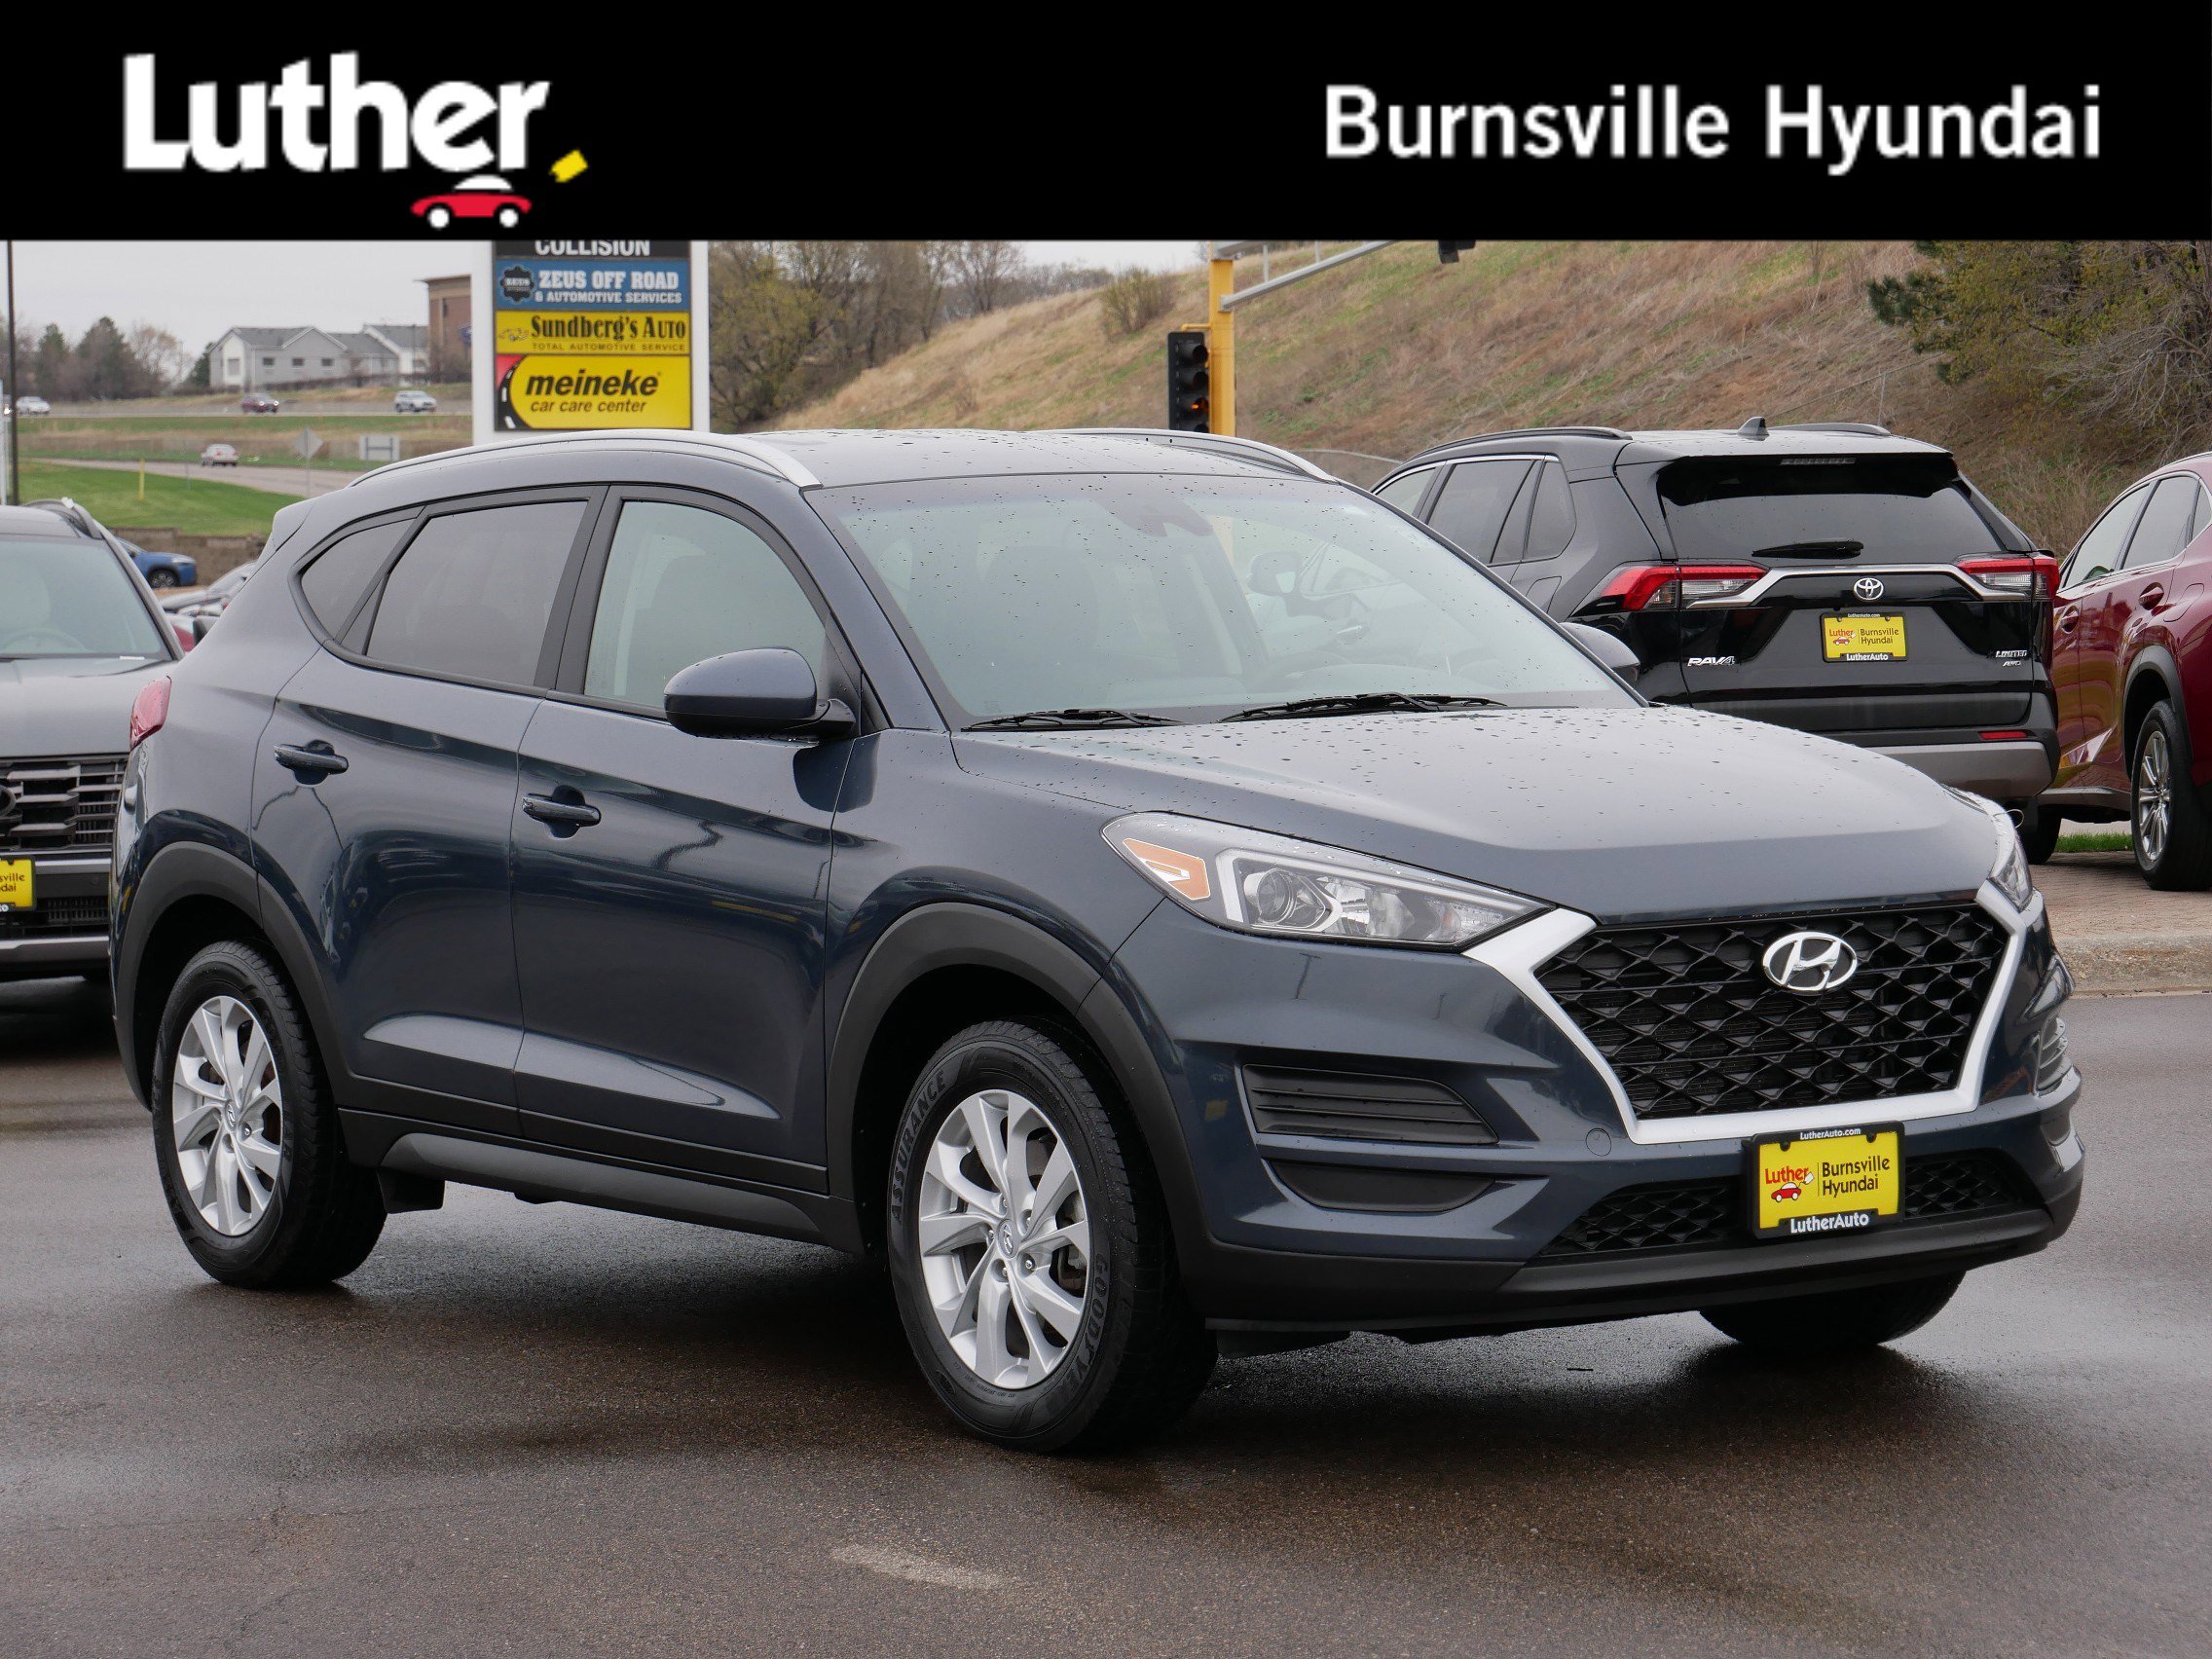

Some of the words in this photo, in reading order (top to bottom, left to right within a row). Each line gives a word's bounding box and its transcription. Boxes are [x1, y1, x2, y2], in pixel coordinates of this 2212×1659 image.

[535, 240, 650, 256] COLLISION
[538, 270, 587, 289] ZEUS
[591, 271, 626, 289] OFF
[631, 271, 680, 290] ROAD
[535, 291, 543, 302] &
[546, 291, 622, 303] AUTOMOTIVE
[625, 292, 682, 304] SERVICES
[531, 315, 638, 341] Sundberg's
[526, 369, 659, 396] meineke
[531, 401, 555, 412] car
[560, 401, 592, 412] care
[598, 399, 646, 412] center
[1861, 636, 1894, 645] Hyundai
[1687, 655, 1735, 667] RAV4
[1799, 1127, 1862, 1141] LutherAuto.com
[890, 1069, 945, 1226] ASSURANCE
[1764, 1165, 1809, 1185] Luther
[1822, 1155, 1891, 1178] Burnsville
[1822, 1174, 1879, 1198] Hyundai
[1790, 1212, 1869, 1234] LutherAuto
